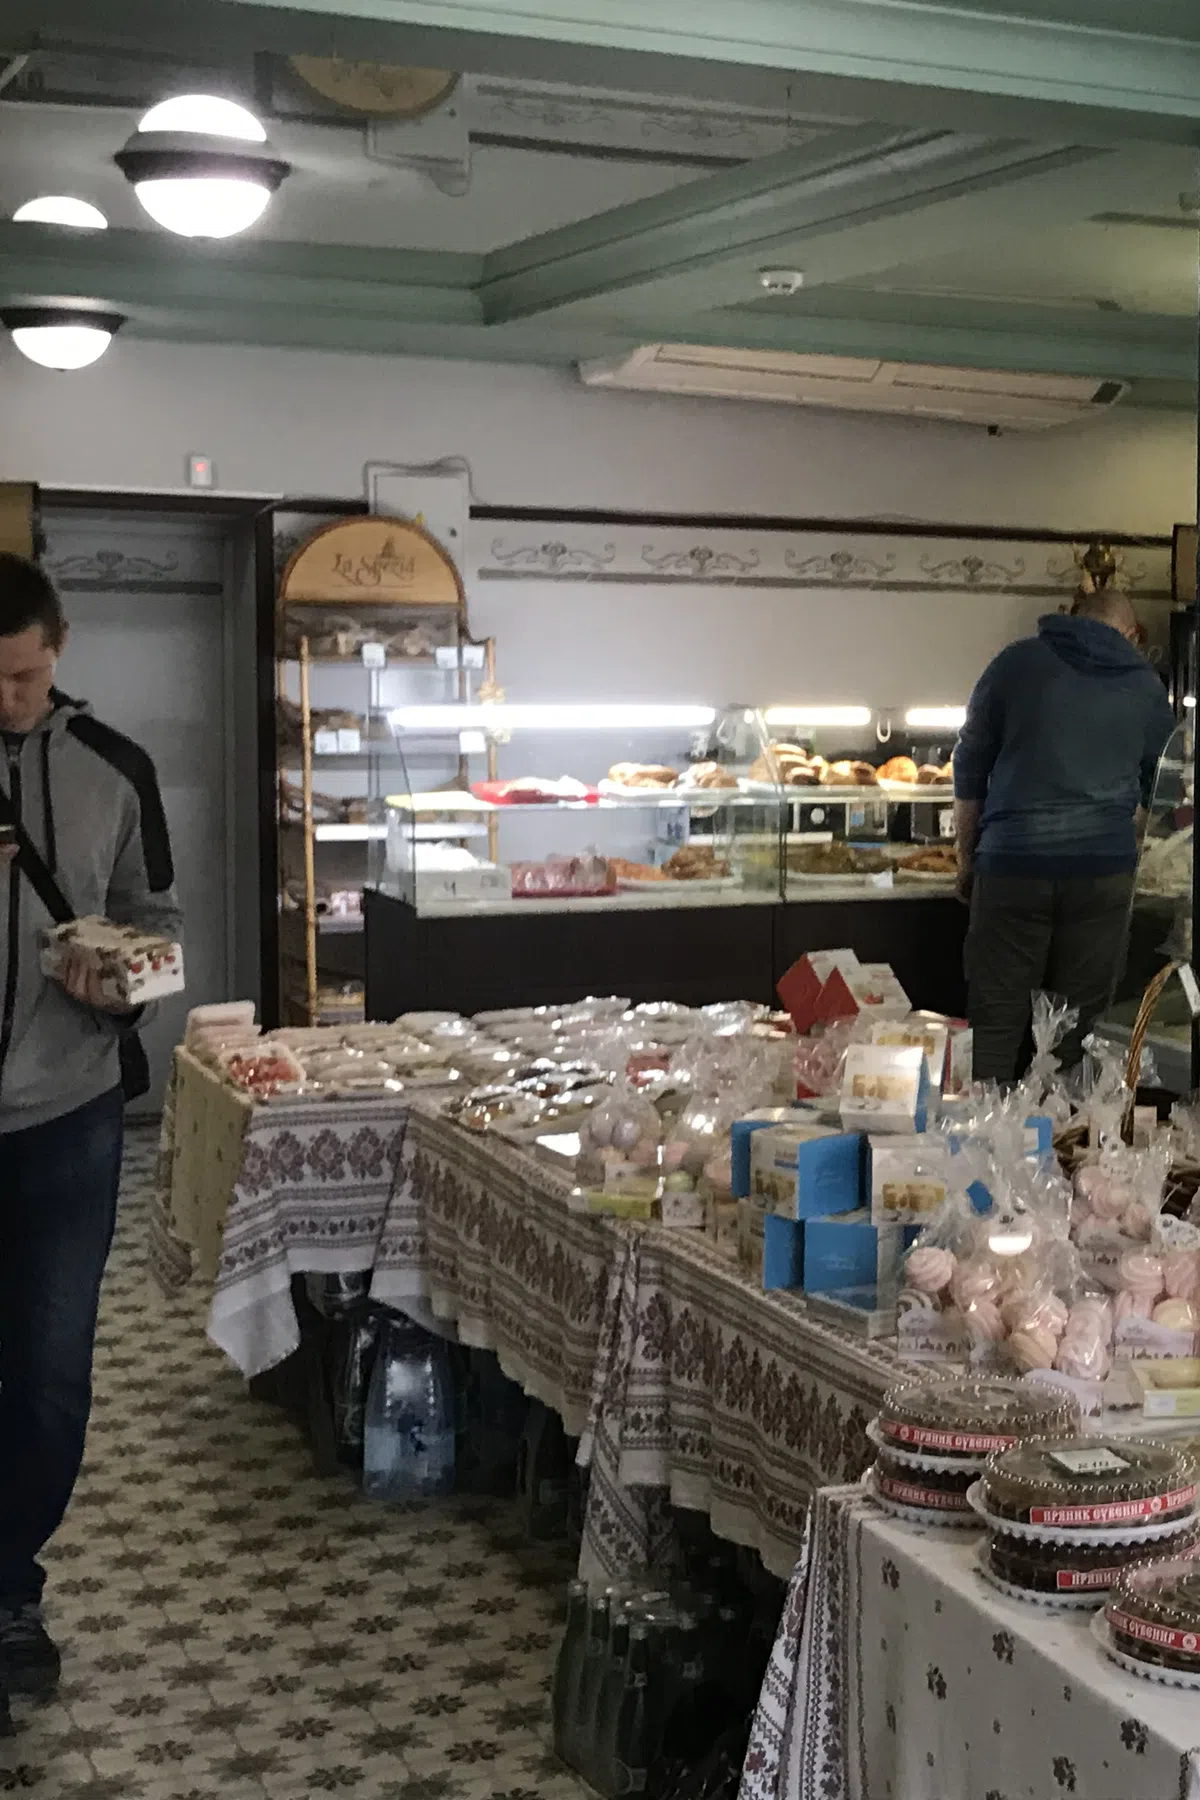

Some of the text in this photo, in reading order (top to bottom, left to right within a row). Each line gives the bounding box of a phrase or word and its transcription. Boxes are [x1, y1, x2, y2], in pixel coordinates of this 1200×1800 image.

[1043, 1502, 1146, 1523] ПРЯНИК СУВЕНИР
[1128, 1620, 1176, 1645] СУВЕНИР
